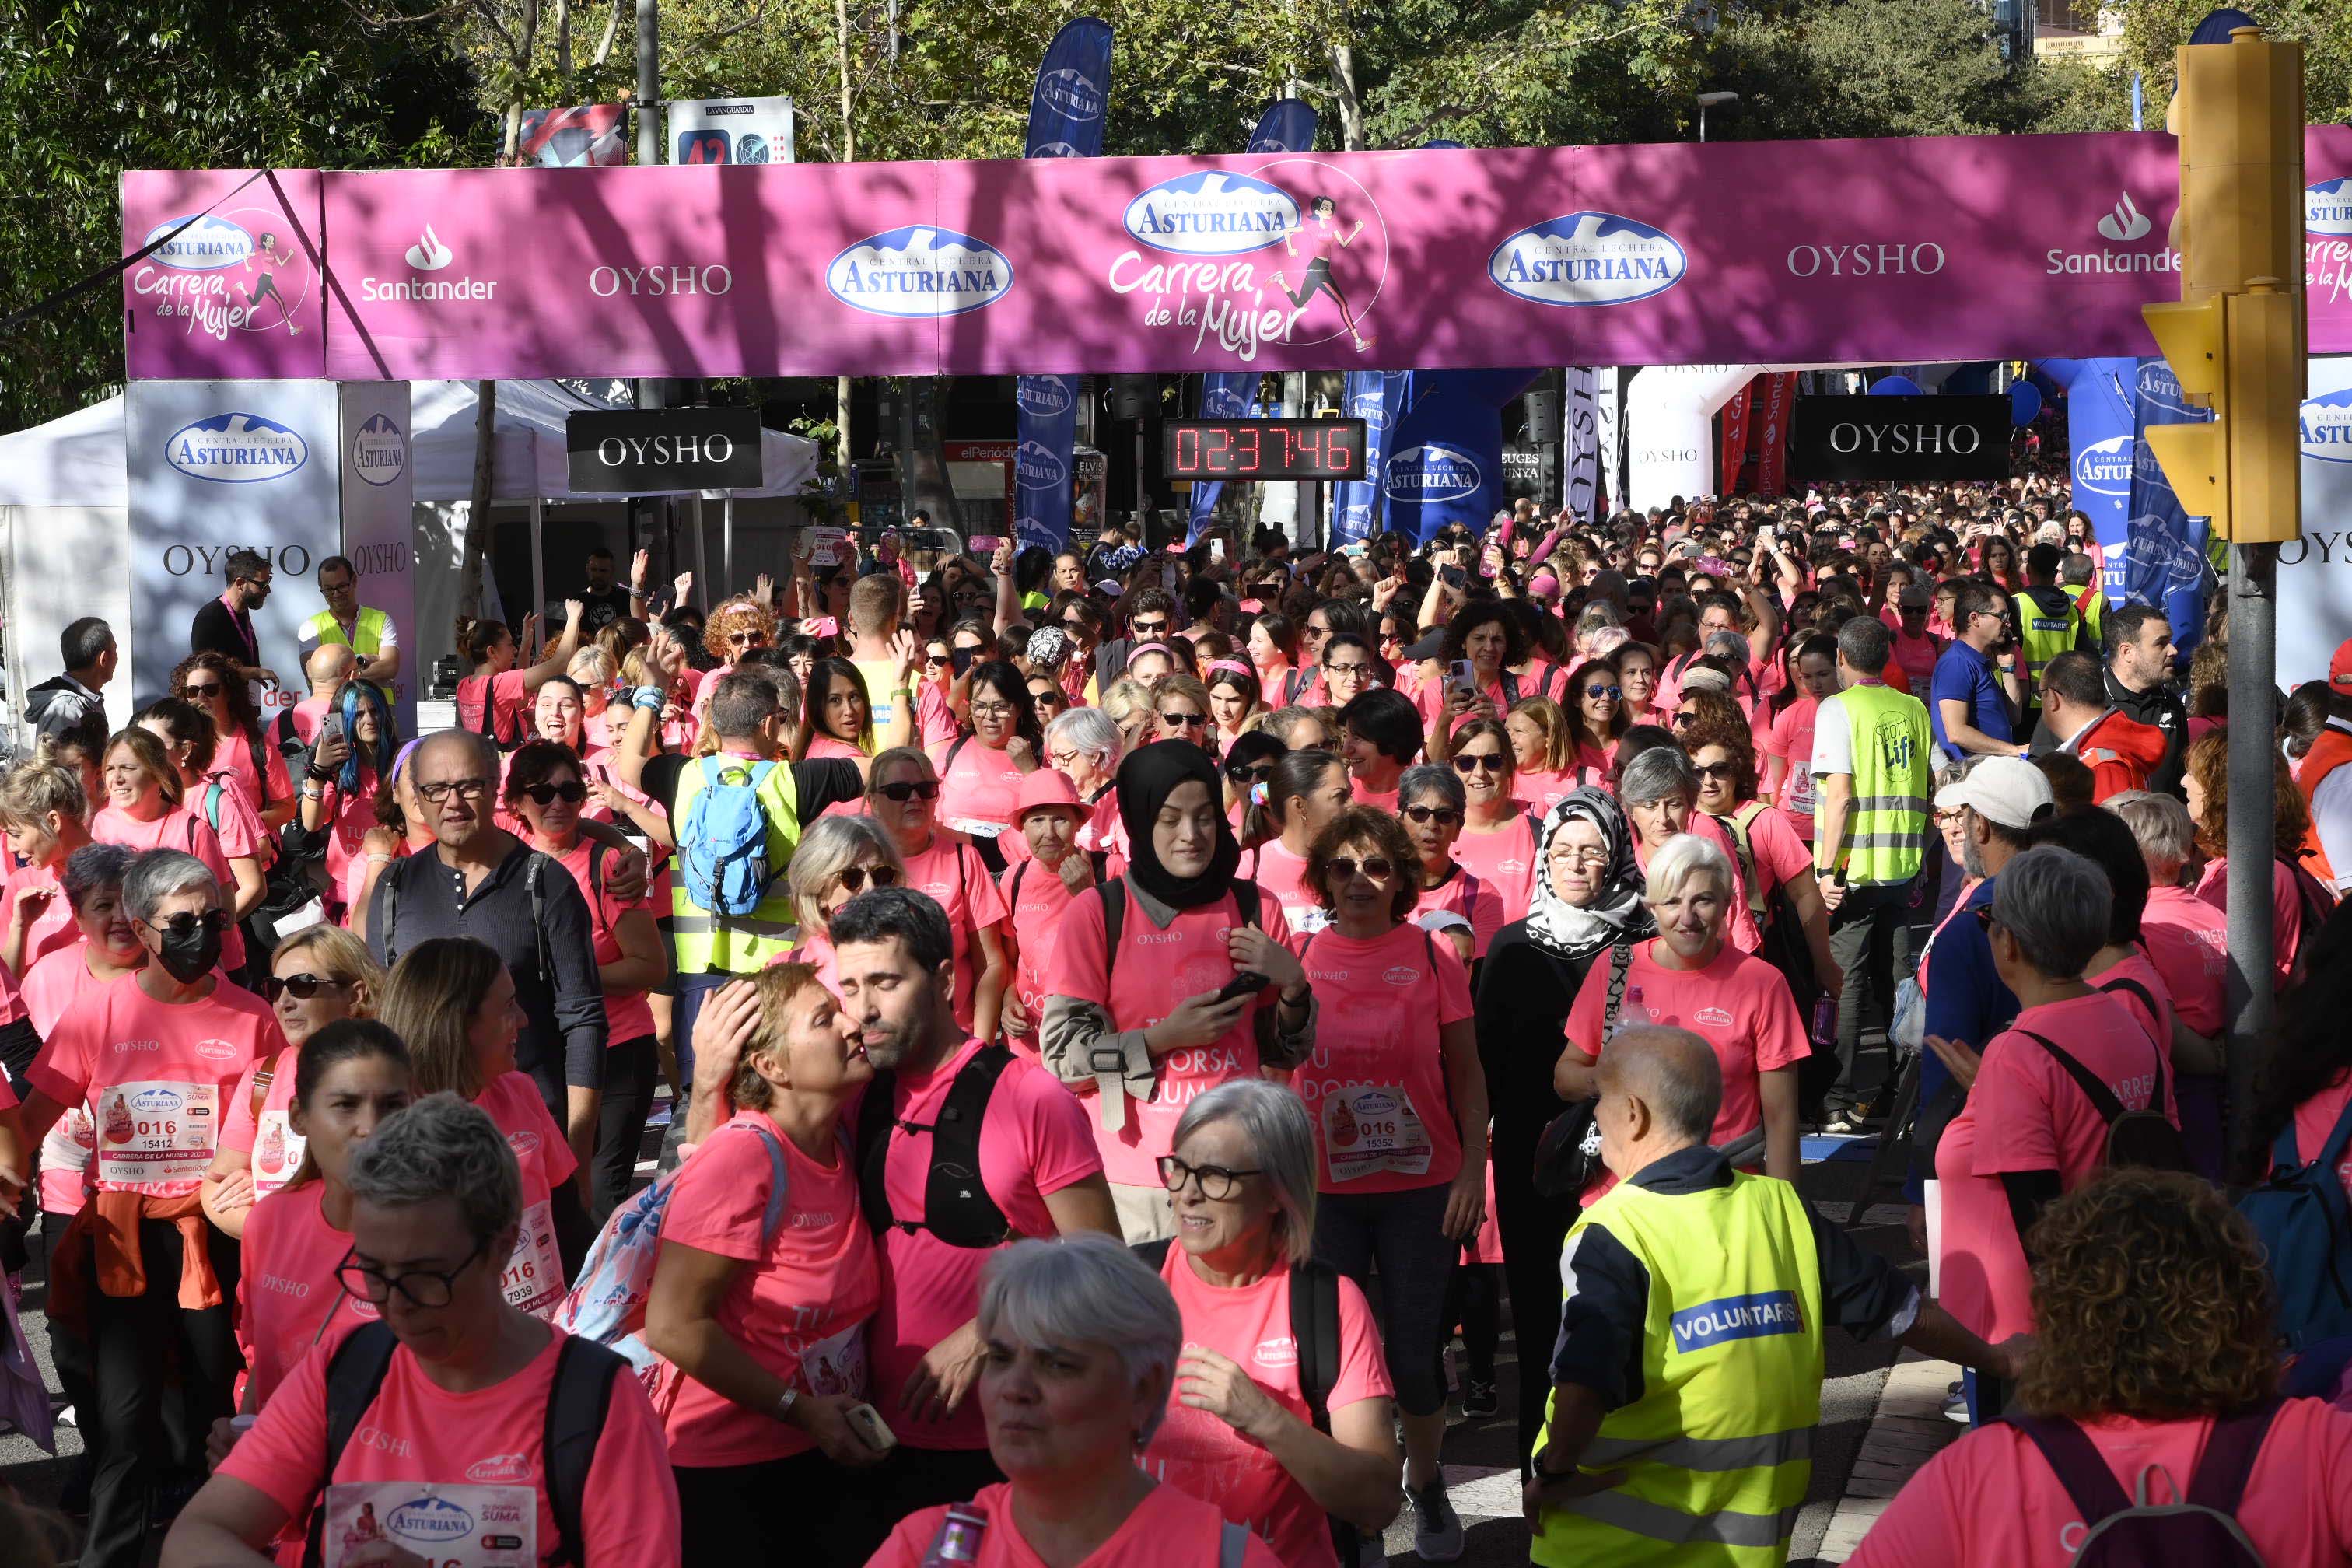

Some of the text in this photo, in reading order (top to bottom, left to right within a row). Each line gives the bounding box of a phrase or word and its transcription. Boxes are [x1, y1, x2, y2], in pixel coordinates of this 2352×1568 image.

[1164, 198, 1282, 208] CENTRAL LECHERA
[1137, 204, 1286, 233] ASTURIANA
[1535, 243, 1664, 254] CENTRAL LECHERA
[869, 257, 992, 266] CENTRAL LECHERA
[1503, 247, 1671, 283] ASTURIANA
[1787, 242, 1945, 277] OYSHO
[2046, 247, 2182, 274] Santande
[135, 266, 224, 295] Carrera
[589, 264, 733, 297] OYSHO
[842, 259, 998, 293] ASTURIANA
[1109, 250, 1254, 293] Carrera
[362, 276, 498, 301] Santander
[156, 296, 190, 317] de la
[187, 292, 261, 340] Mujer
[1145, 295, 1196, 327] de la
[1193, 289, 1307, 361] Mujer
[1353, 401, 1382, 420] ASTUR
[1570, 367, 1594, 518] OYSH
[1830, 422, 1979, 454] OYSHO
[177, 439, 296, 465] ASTURIANA
[357, 443, 402, 467] ASTURIANA
[598, 434, 733, 466] OYSHO
[961, 446, 1017, 458] elPeriódi
[1177, 428, 1349, 471] 02:37:46
[1502, 453, 1540, 464] EUGES
[1639, 448, 1697, 464] OYSHO
[1079, 462, 1103, 471] ELVIS
[1503, 468, 1538, 478] UNYA
[1386, 471, 1473, 490] ASTURIANA
[163, 544, 310, 576] OYO
[355, 542, 405, 576] OYSHO
[1876, 719, 1909, 745] Sport
[1883, 736, 1915, 770] Life
[1018, 903, 1048, 912] OYSHO
[1137, 932, 1182, 944] OYSHO
[1308, 971, 1348, 981] OYSHO
[1697, 1013, 1730, 1023] ASTURIANA
[115, 1040, 159, 1053] OYSHO
[199, 1046, 233, 1055] ASTURIANA
[135, 1098, 179, 1108] ASTURIANA
[1356, 1101, 1395, 1110] ASTURIANA
[138, 1121, 177, 1136] 016
[1362, 1121, 1395, 1136] 016
[142, 1139, 173, 1149] 15412
[1366, 1139, 1393, 1148] 15352
[110, 1166, 144, 1176] OYSHO
[173, 1165, 208, 1174] Santander
[792, 1213, 834, 1227] OYSHO
[262, 1273, 309, 1298] OYSHO
[507, 1285, 533, 1304] 7939
[1676, 1303, 1796, 1341] VOLUNTARIS
[394, 1516, 467, 1532] ASTURIANA
[481, 1511, 520, 1521] SUMA
